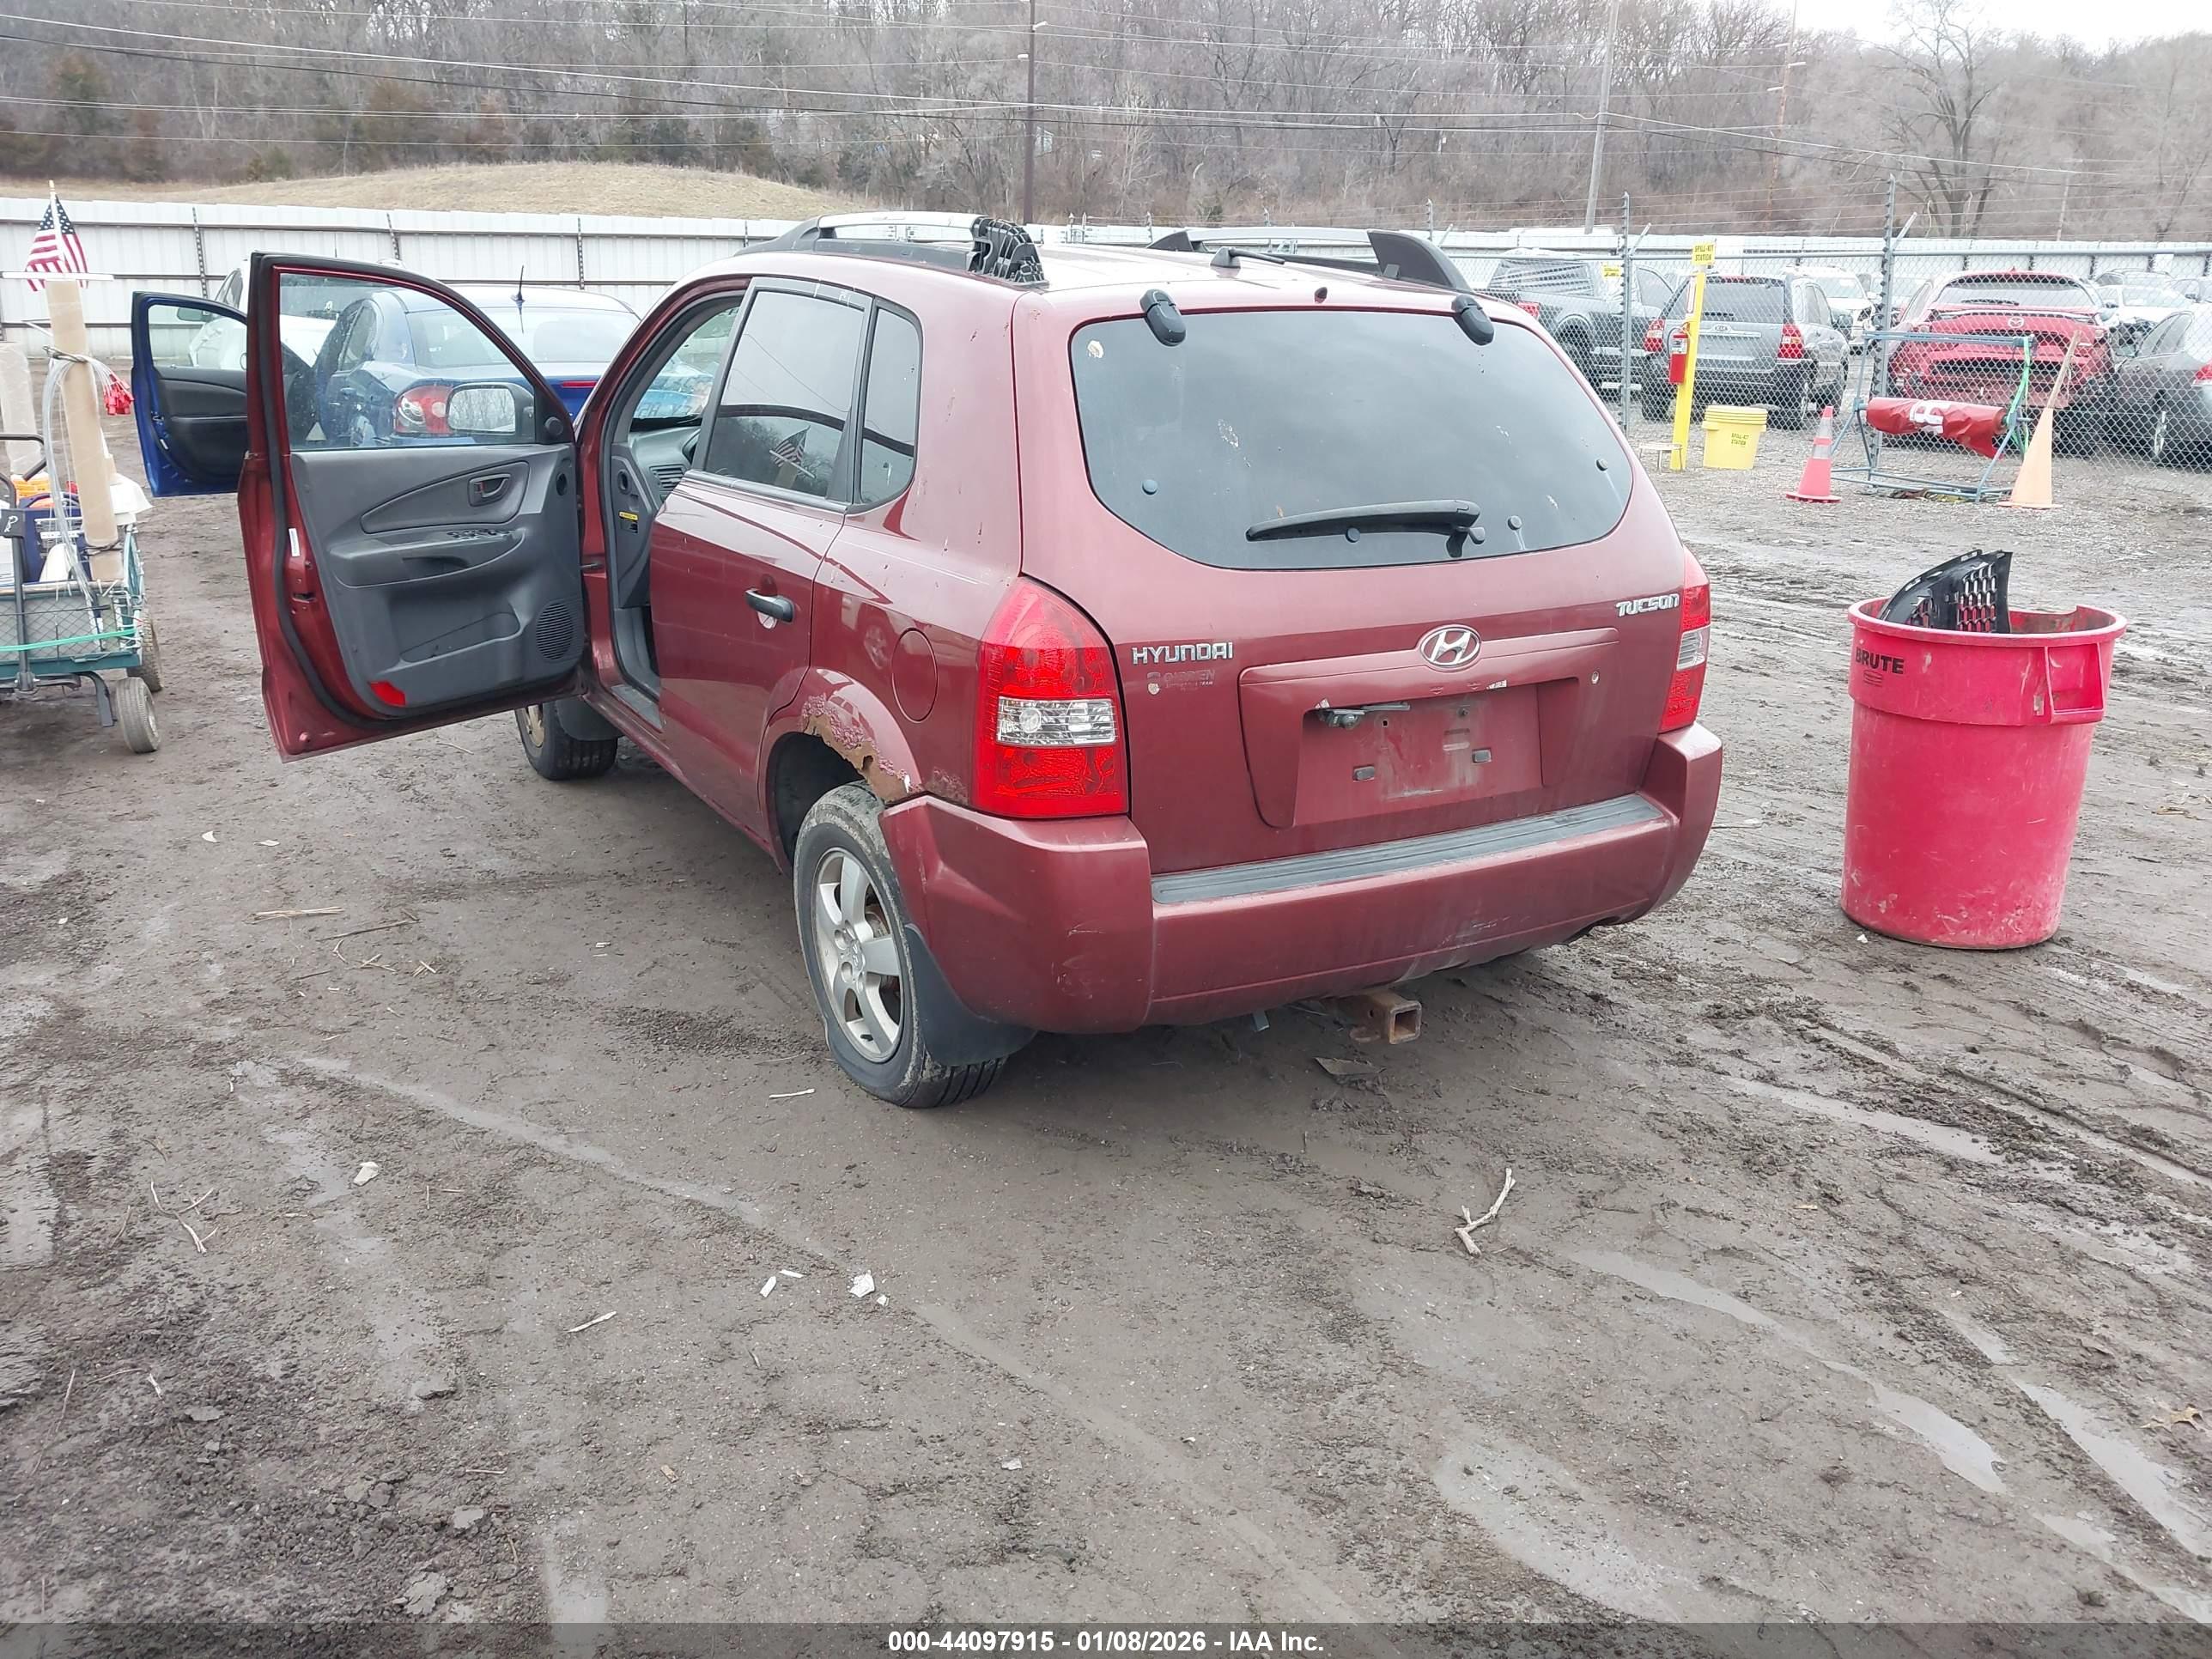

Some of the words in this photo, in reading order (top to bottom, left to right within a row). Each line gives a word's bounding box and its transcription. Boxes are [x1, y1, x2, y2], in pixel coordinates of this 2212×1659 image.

[1615, 593, 1680, 617] TUCSON
[1132, 641, 1233, 665] HYUNDAI
[1855, 647, 1905, 675] BRUTE
